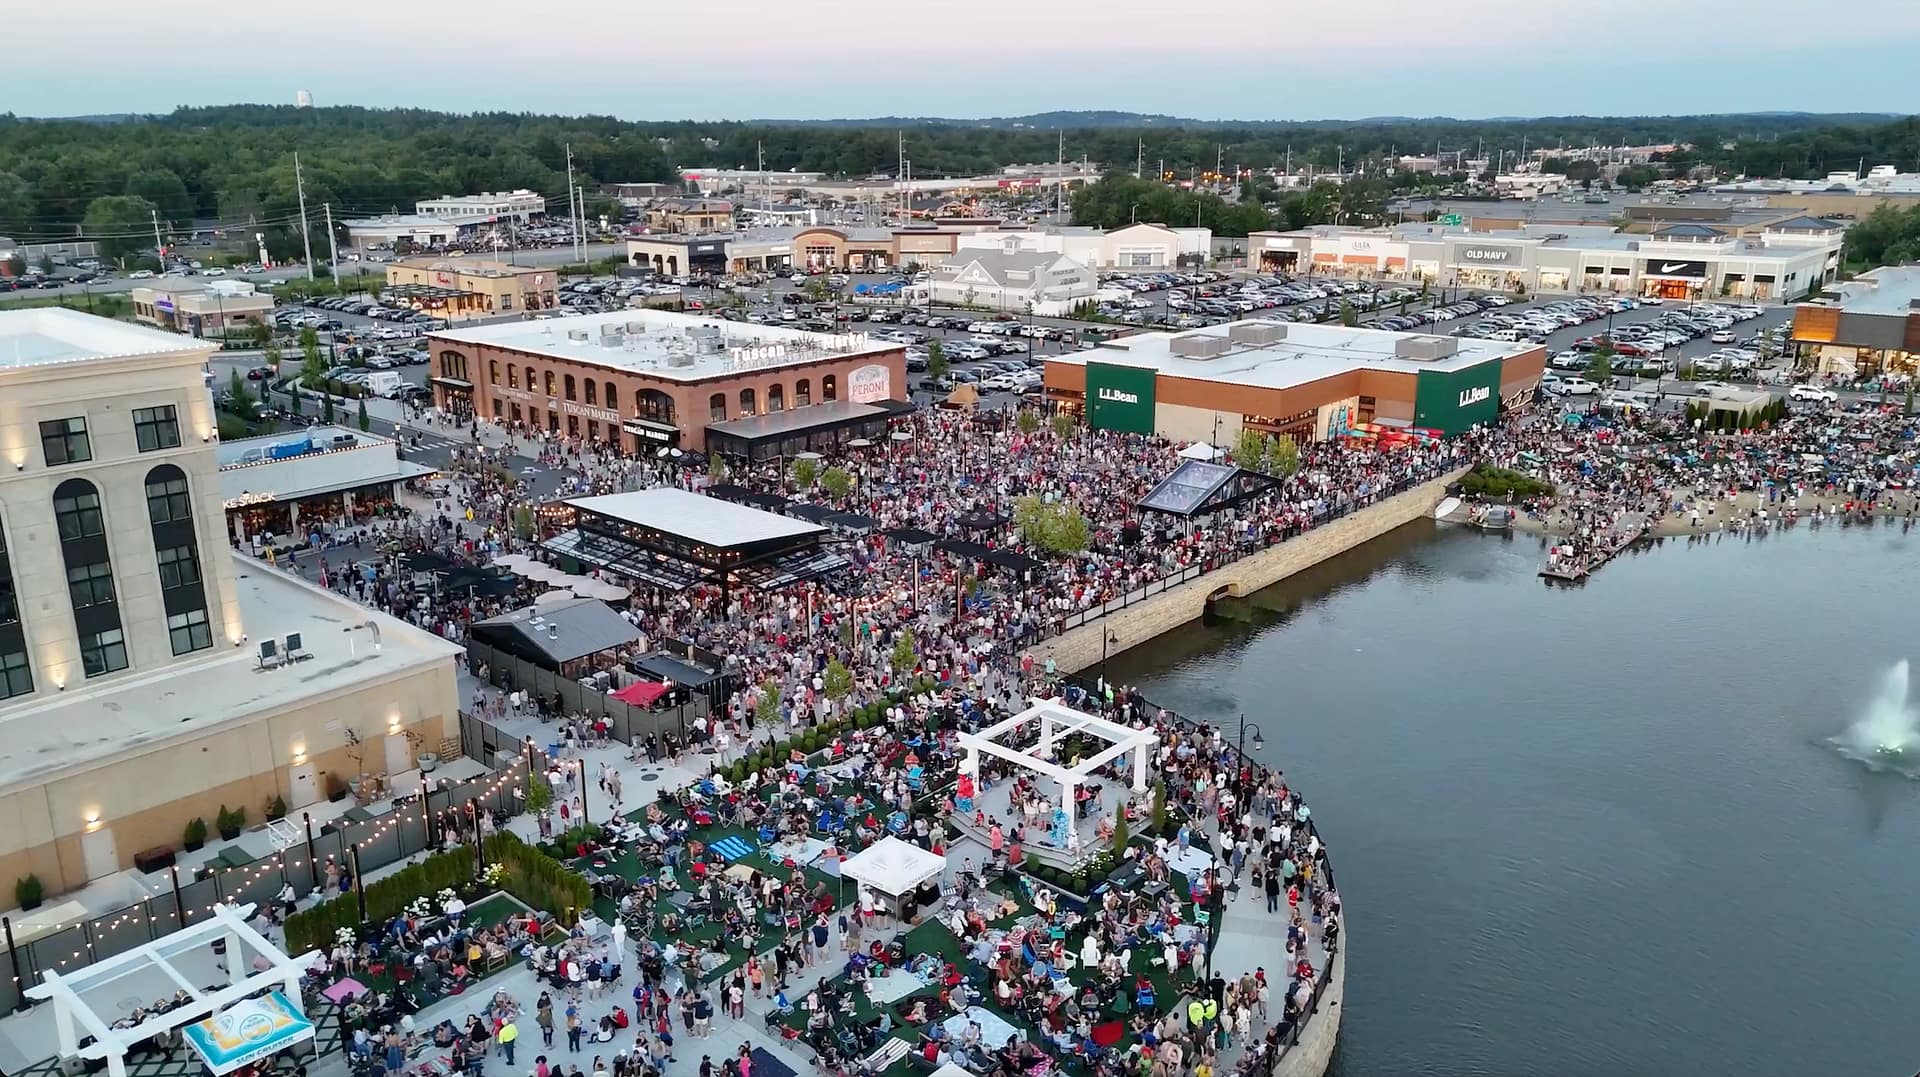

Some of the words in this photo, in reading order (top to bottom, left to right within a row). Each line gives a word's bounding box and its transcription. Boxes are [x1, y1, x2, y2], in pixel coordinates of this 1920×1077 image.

[1466, 250, 1483, 259] OLD
[1483, 250, 1508, 260] NAVY
[730, 344, 785, 363] Tuscan
[821, 330, 869, 350] Market
[852, 381, 885, 397] PERONI
[562, 402, 591, 418] TUSCAN
[591, 406, 620, 423] MARKET
[222, 497, 238, 510] KE
[238, 490, 277, 507] SHACK
[236, 1052, 255, 1064] SUN
[256, 1036, 295, 1055] CRUISER
